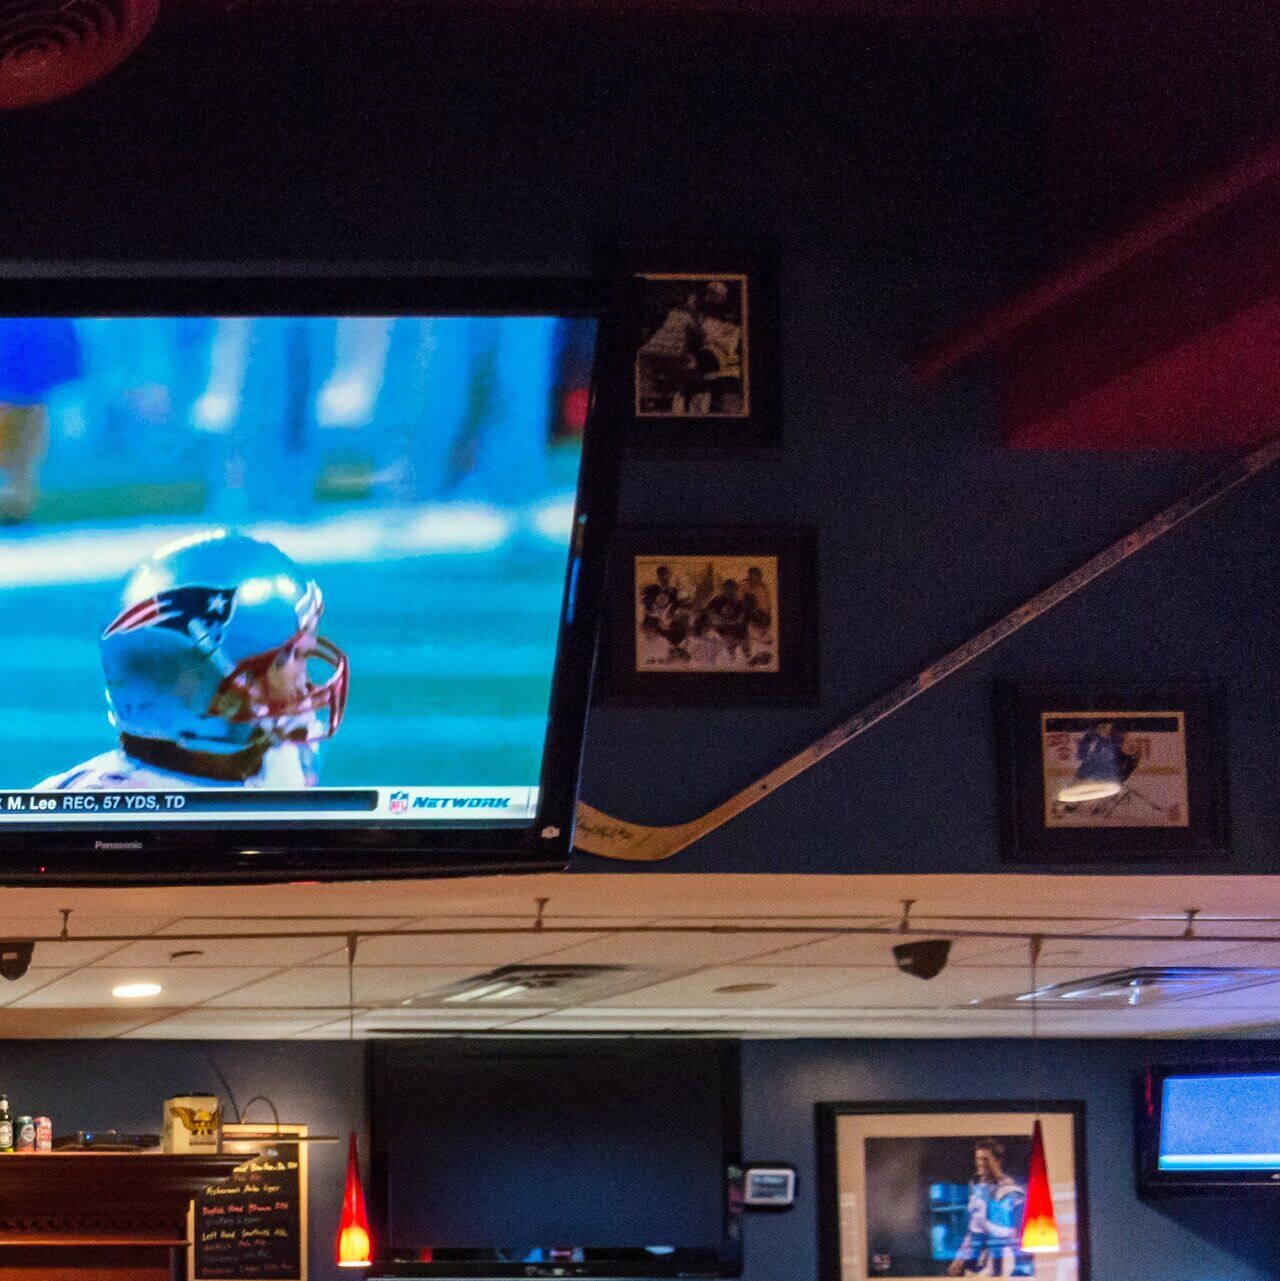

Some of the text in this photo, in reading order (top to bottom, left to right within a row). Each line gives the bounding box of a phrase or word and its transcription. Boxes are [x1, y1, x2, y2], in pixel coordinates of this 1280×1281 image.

[7, 797, 26, 809] M.
[29, 797, 57, 810] Lee
[62, 796, 99, 810] REC,
[103, 796, 122, 808] 57
[124, 796, 160, 811] YDS,
[165, 796, 186, 808] TD
[412, 797, 511, 809] NETWORK
